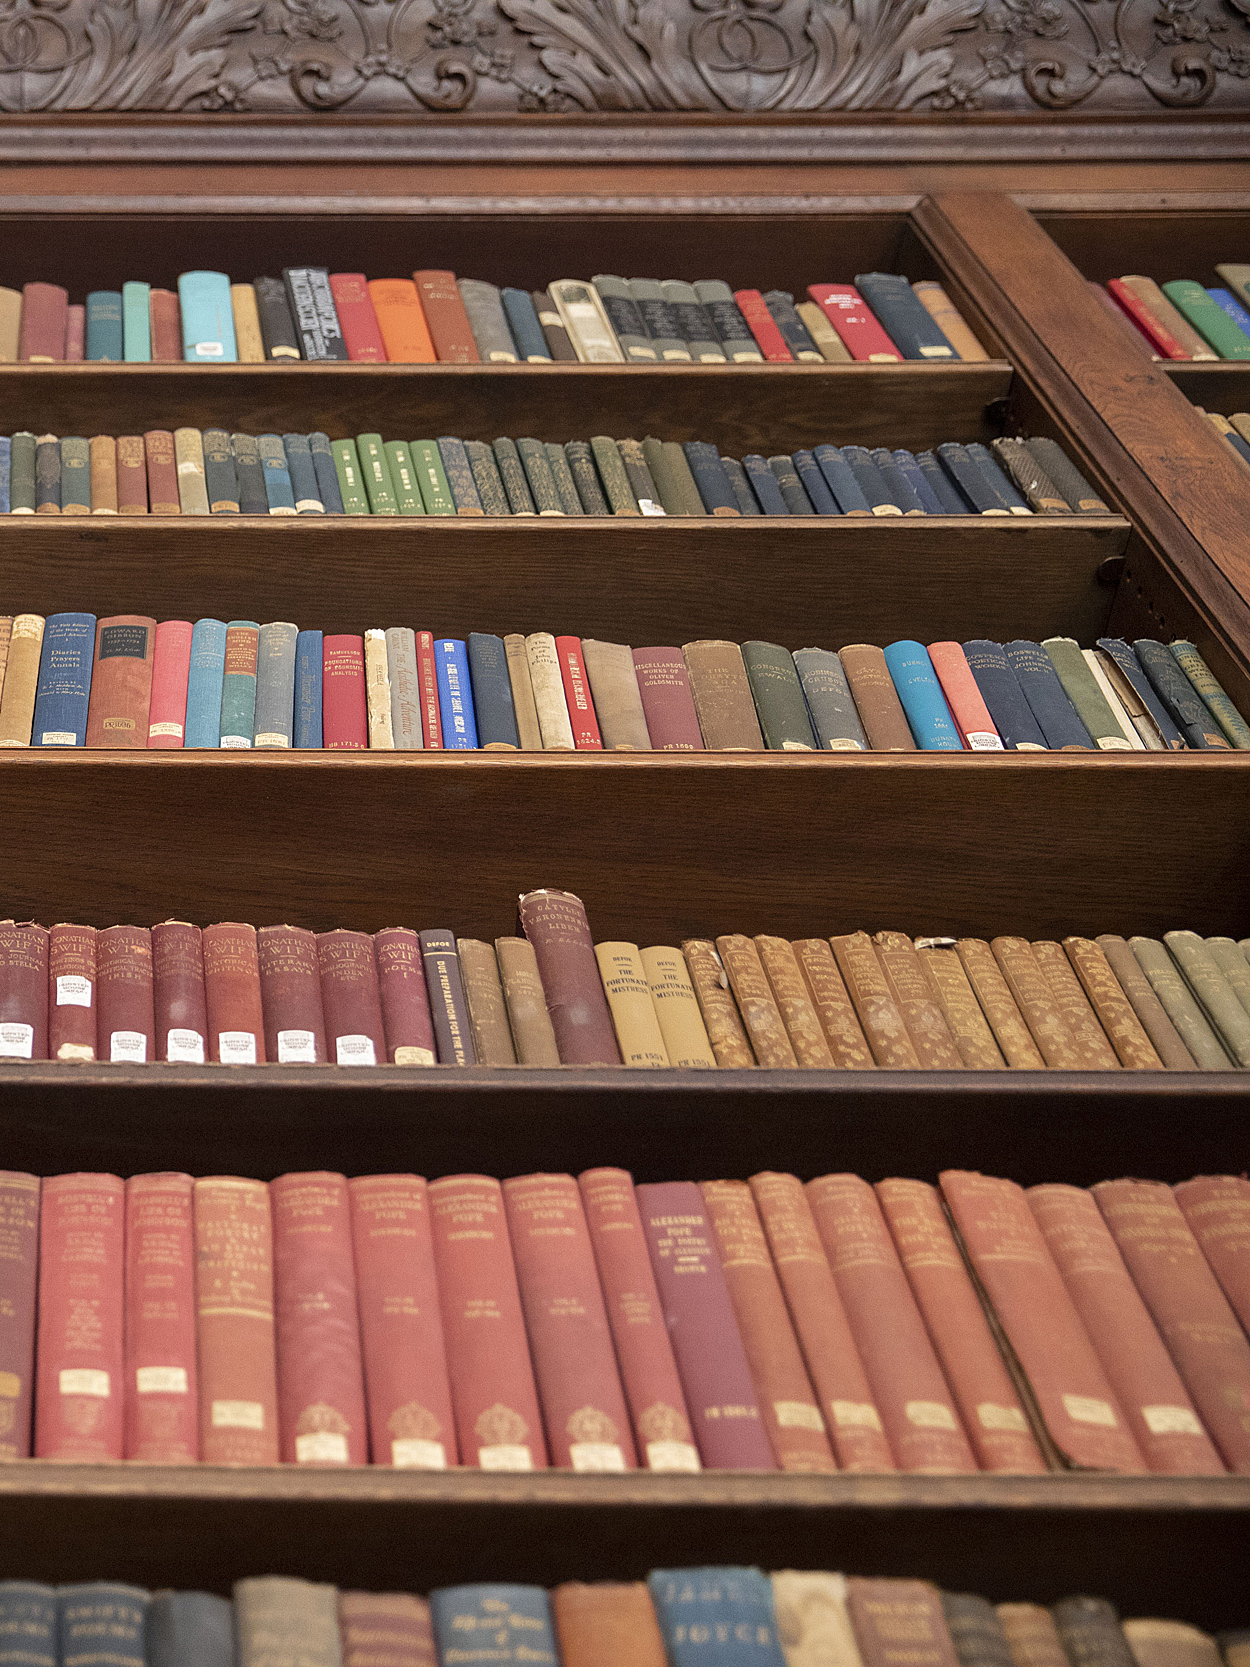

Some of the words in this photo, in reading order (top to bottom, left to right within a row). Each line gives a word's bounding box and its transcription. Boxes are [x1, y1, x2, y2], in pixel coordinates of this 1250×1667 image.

[1007, 650, 1049, 660] BOSWELL'S
[1014, 661, 1053, 671] JOHNSON
[812, 686, 849, 697] DEFOE
[548, 922, 581, 933] LIBER
[50, 935, 96, 946] JONATHAN
[99, 937, 152, 950] JONATHAN
[206, 938, 256, 950] JONATHAN
[259, 938, 316, 951] JONATHAN
[51, 943, 95, 955] SWIFT
[204, 946, 255, 958] SWIFT
[258, 946, 316, 960] SWIFT
[319, 941, 371, 954] JONATHAN
[7, 953, 44, 966] JOURNAL
[319, 949, 372, 962] SWIFT
[9, 960, 40, 971] STELLA
[261, 959, 315, 971] LITERARY
[437, 960, 447, 974] DUE
[108, 972, 141, 981] IRISH
[265, 966, 312, 976] ESSAYS
[332, 970, 363, 978] INDEX
[605, 977, 649, 987] FORTUNATE
[650, 982, 693, 992] FORTUNATE
[611, 986, 649, 995] MISTRESS
[656, 991, 693, 999] MISTRESS
[439, 974, 456, 1020] PREPARATION
[449, 1020, 460, 1035] FOR
[452, 1035, 463, 1049] THE
[631, 1053, 642, 1061] PR
[646, 1052, 663, 1061] 1551
[678, 1058, 689, 1066] PR
[674, 1622, 771, 1645] JOYCE
